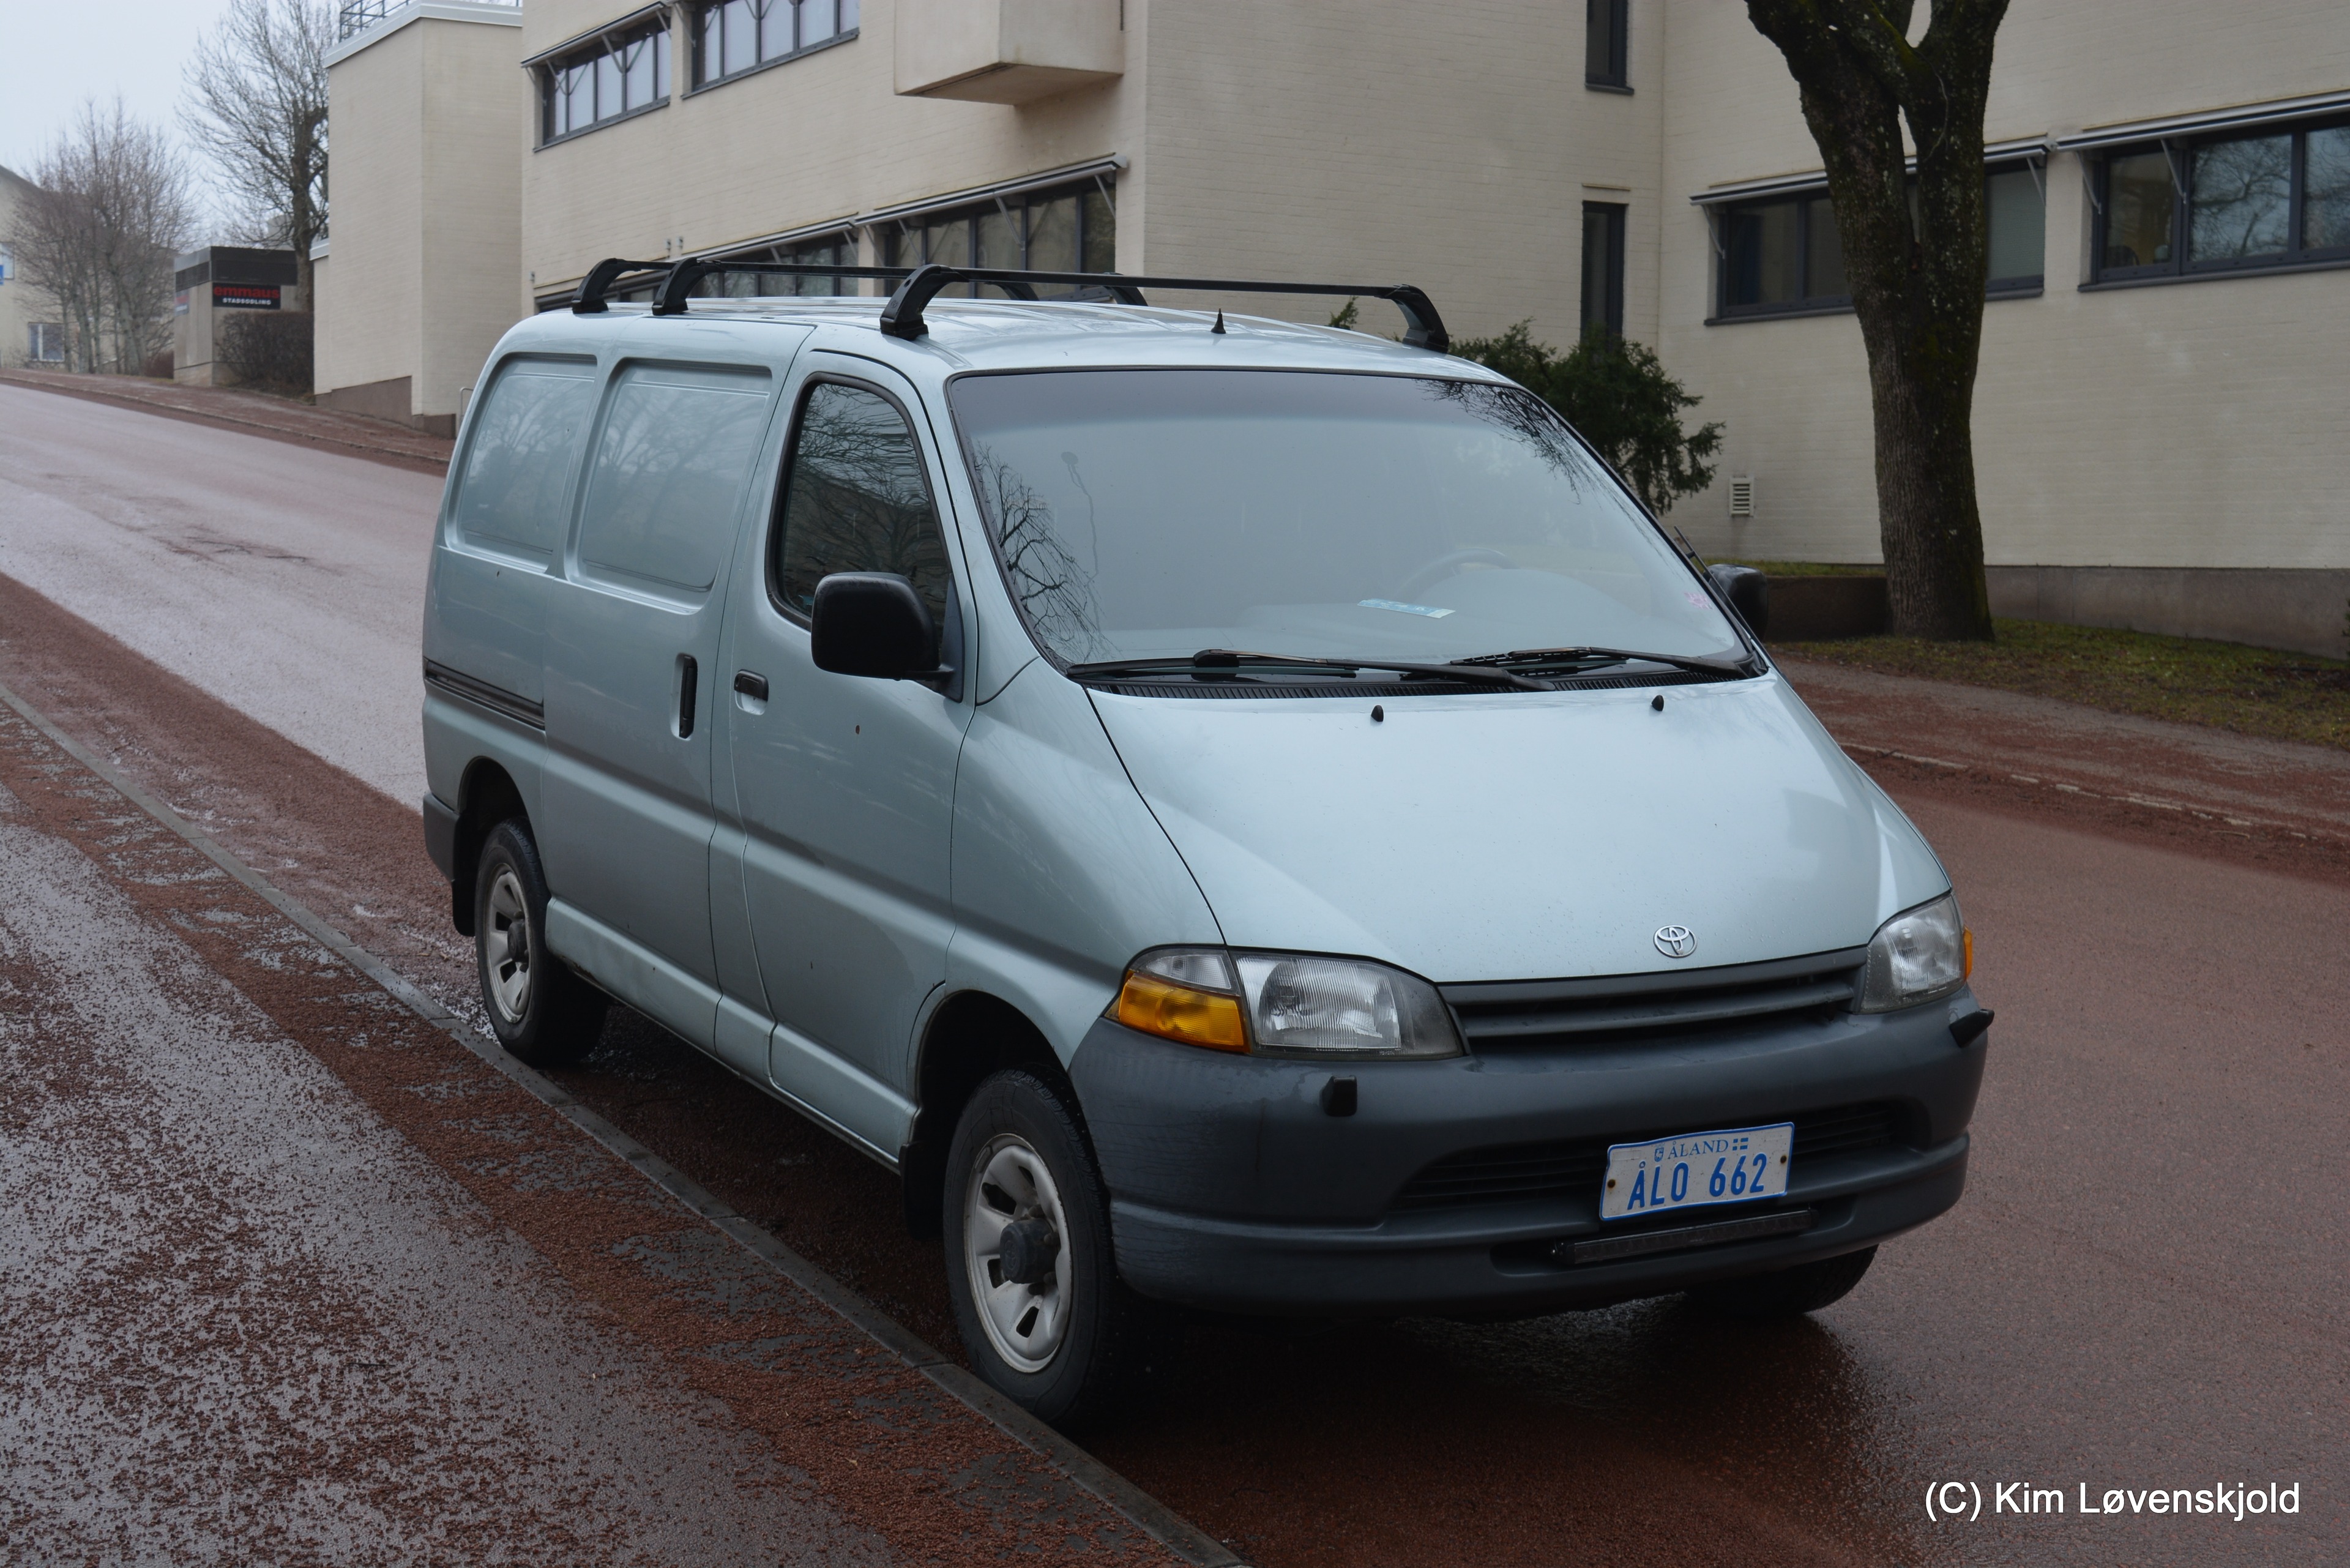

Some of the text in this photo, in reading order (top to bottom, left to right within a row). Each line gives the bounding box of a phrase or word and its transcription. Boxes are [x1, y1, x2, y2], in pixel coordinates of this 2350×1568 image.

[214, 286, 279, 299] emmaus
[1668, 1140, 1728, 1159] ÅLAND
[1627, 1152, 1767, 1210] ÅLO 662
